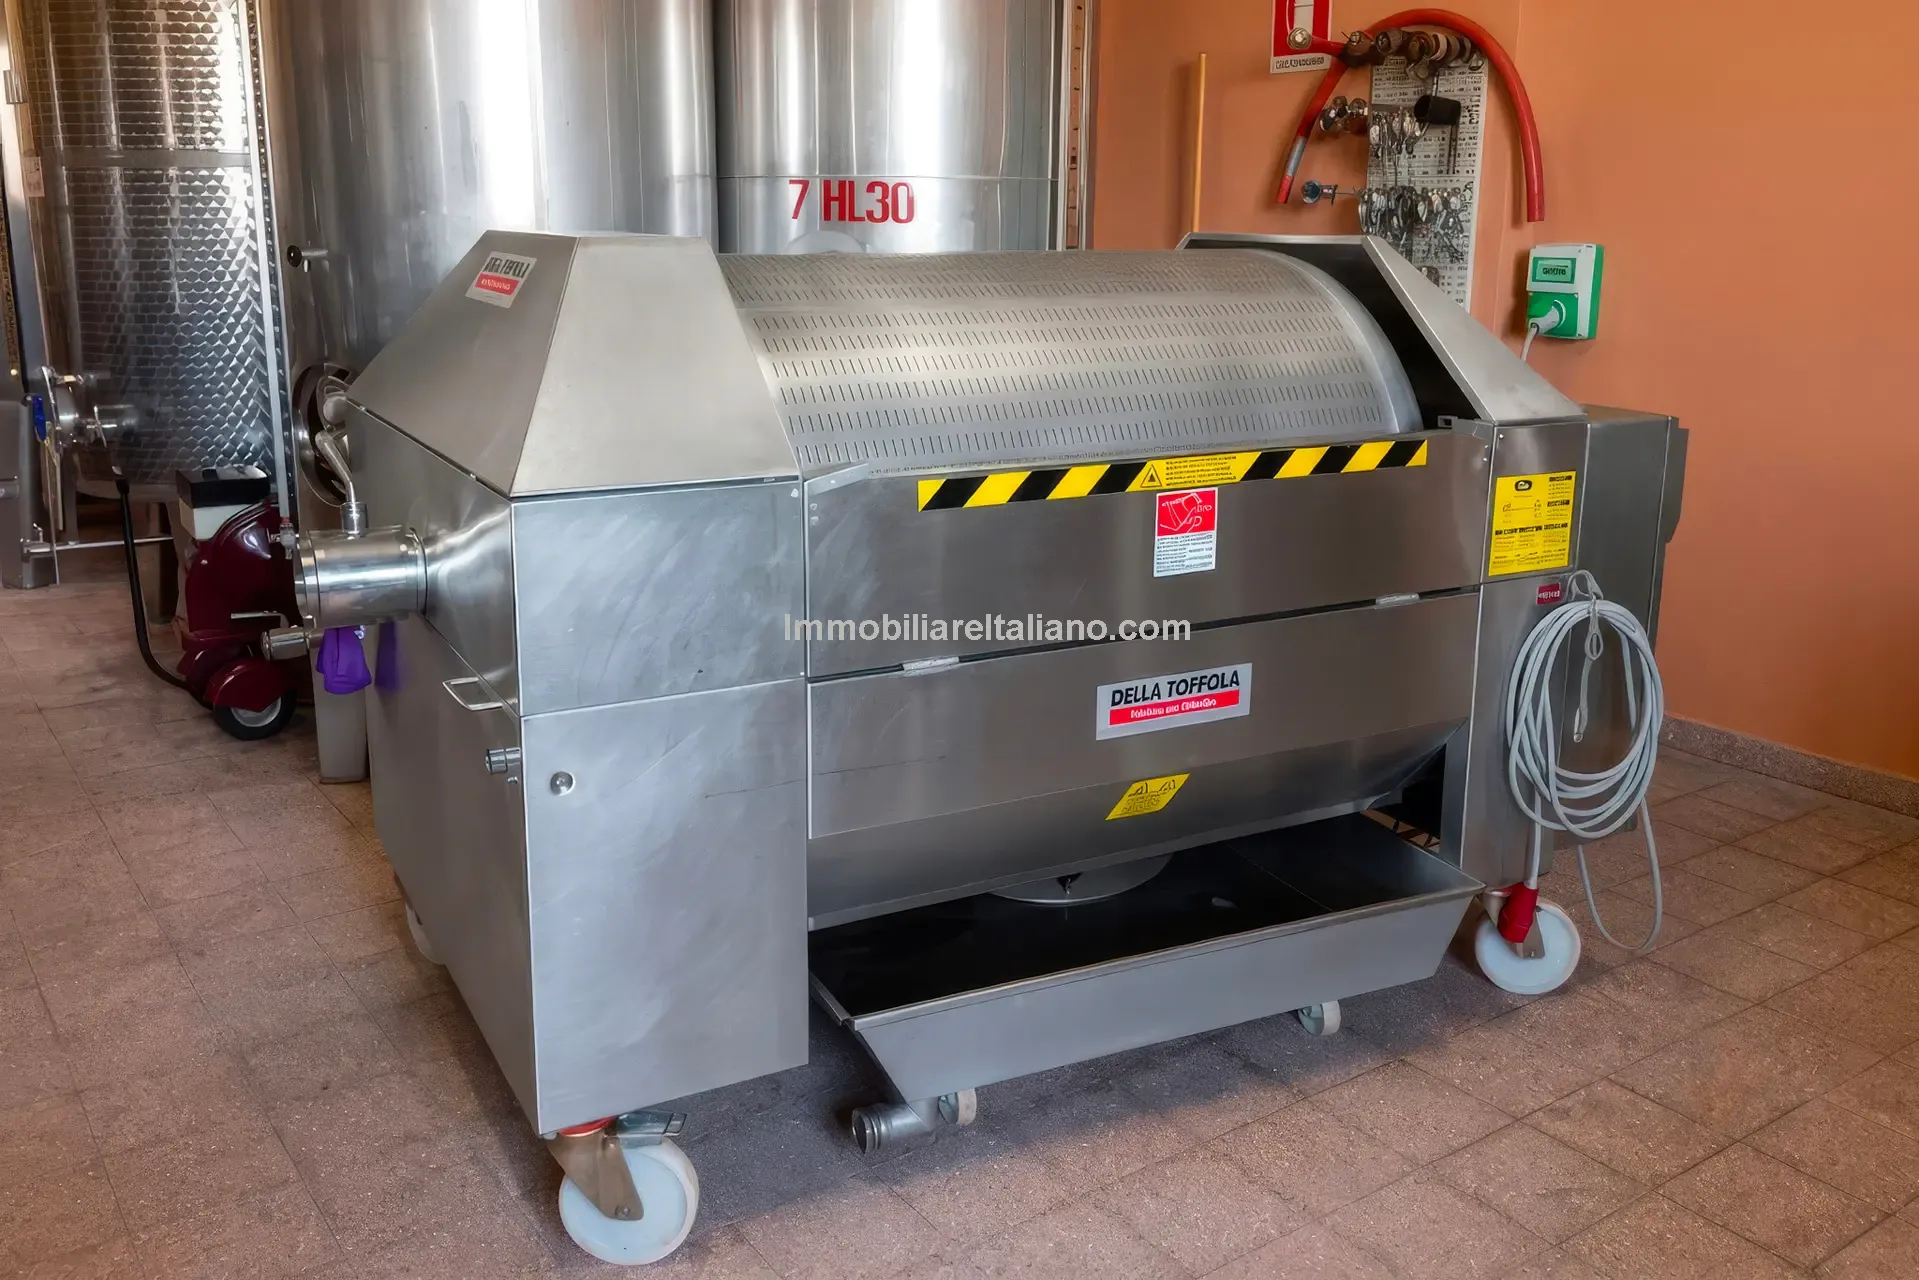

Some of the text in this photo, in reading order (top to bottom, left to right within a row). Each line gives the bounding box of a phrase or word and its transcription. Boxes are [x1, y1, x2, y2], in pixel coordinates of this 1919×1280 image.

[788, 179, 915, 223] 7 HL30
[1111, 670, 1240, 706] DELLA TOFFOLA
